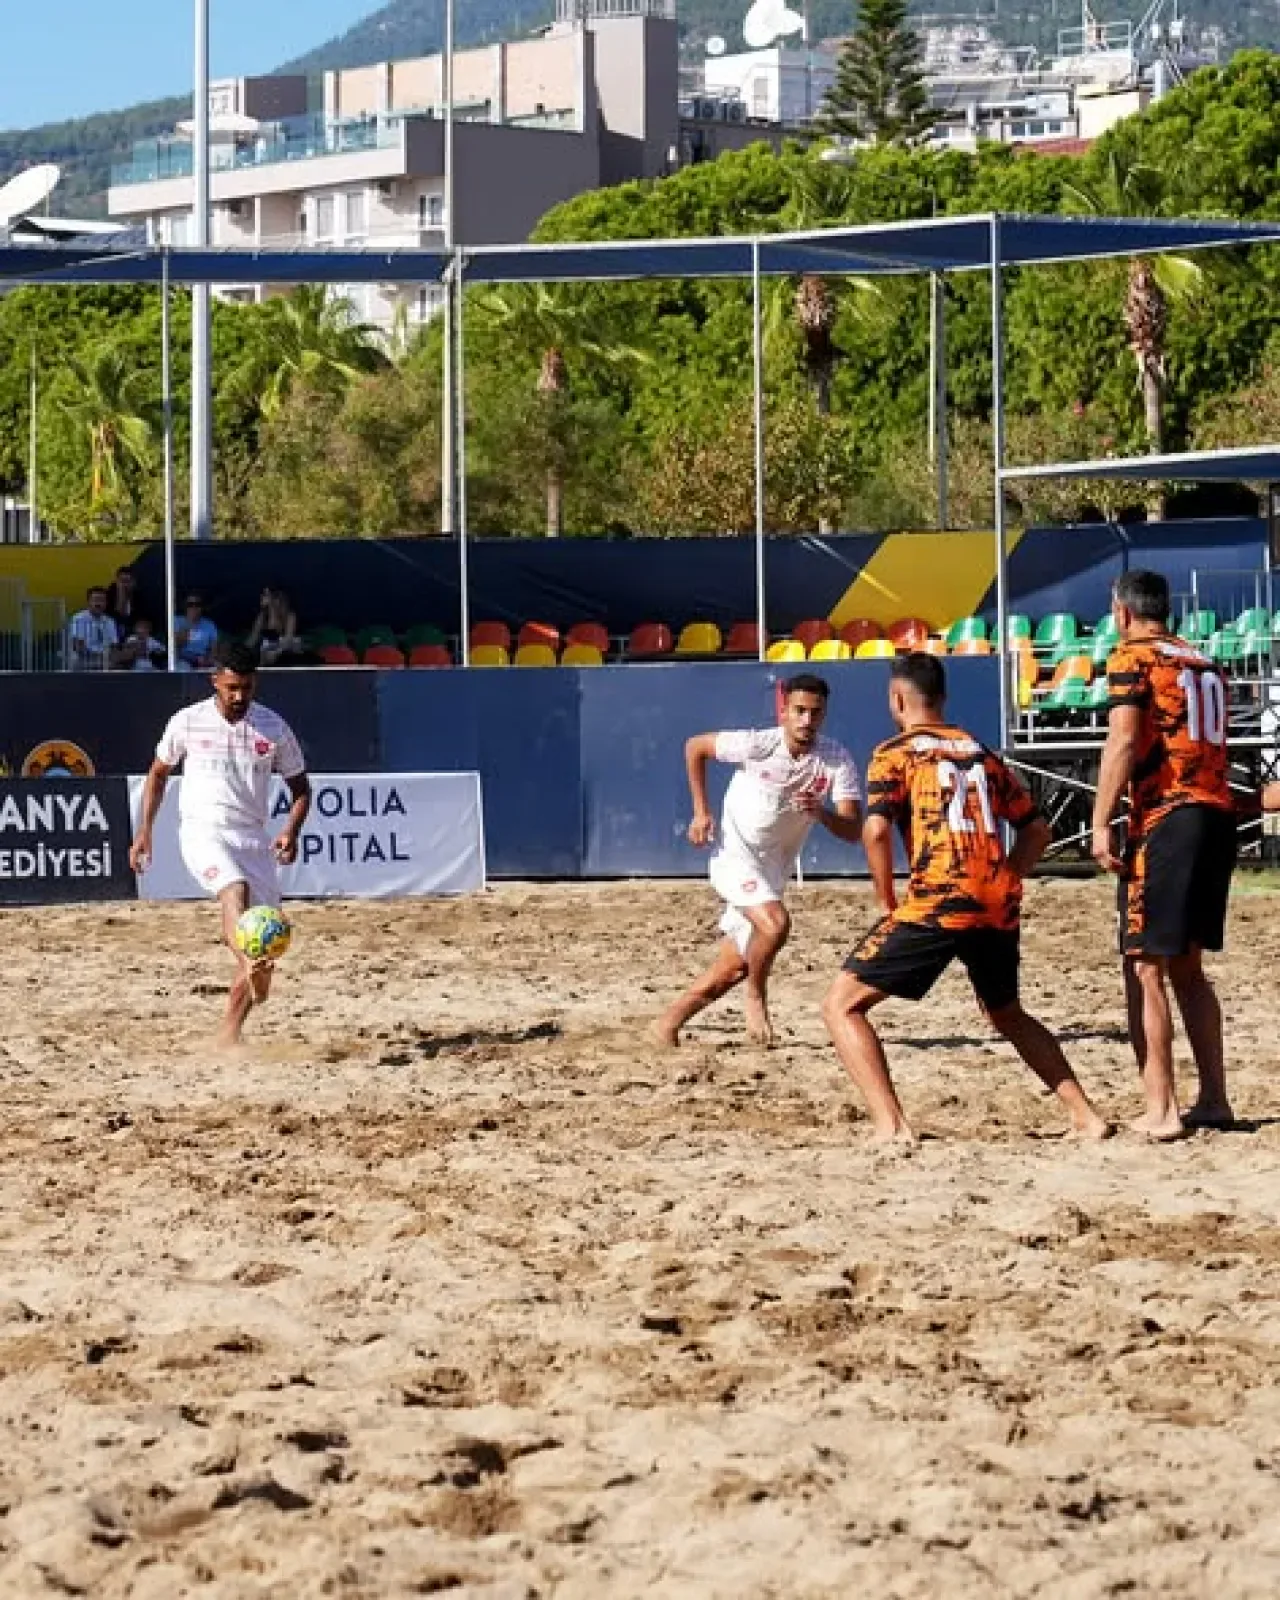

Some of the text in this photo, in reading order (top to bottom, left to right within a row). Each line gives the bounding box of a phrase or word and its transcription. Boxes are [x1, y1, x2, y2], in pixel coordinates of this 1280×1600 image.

[1176, 669, 1224, 746] 10
[0, 794, 109, 832] ANYA
[271, 786, 407, 819] AOLIA
[303, 832, 410, 863] PITAL
